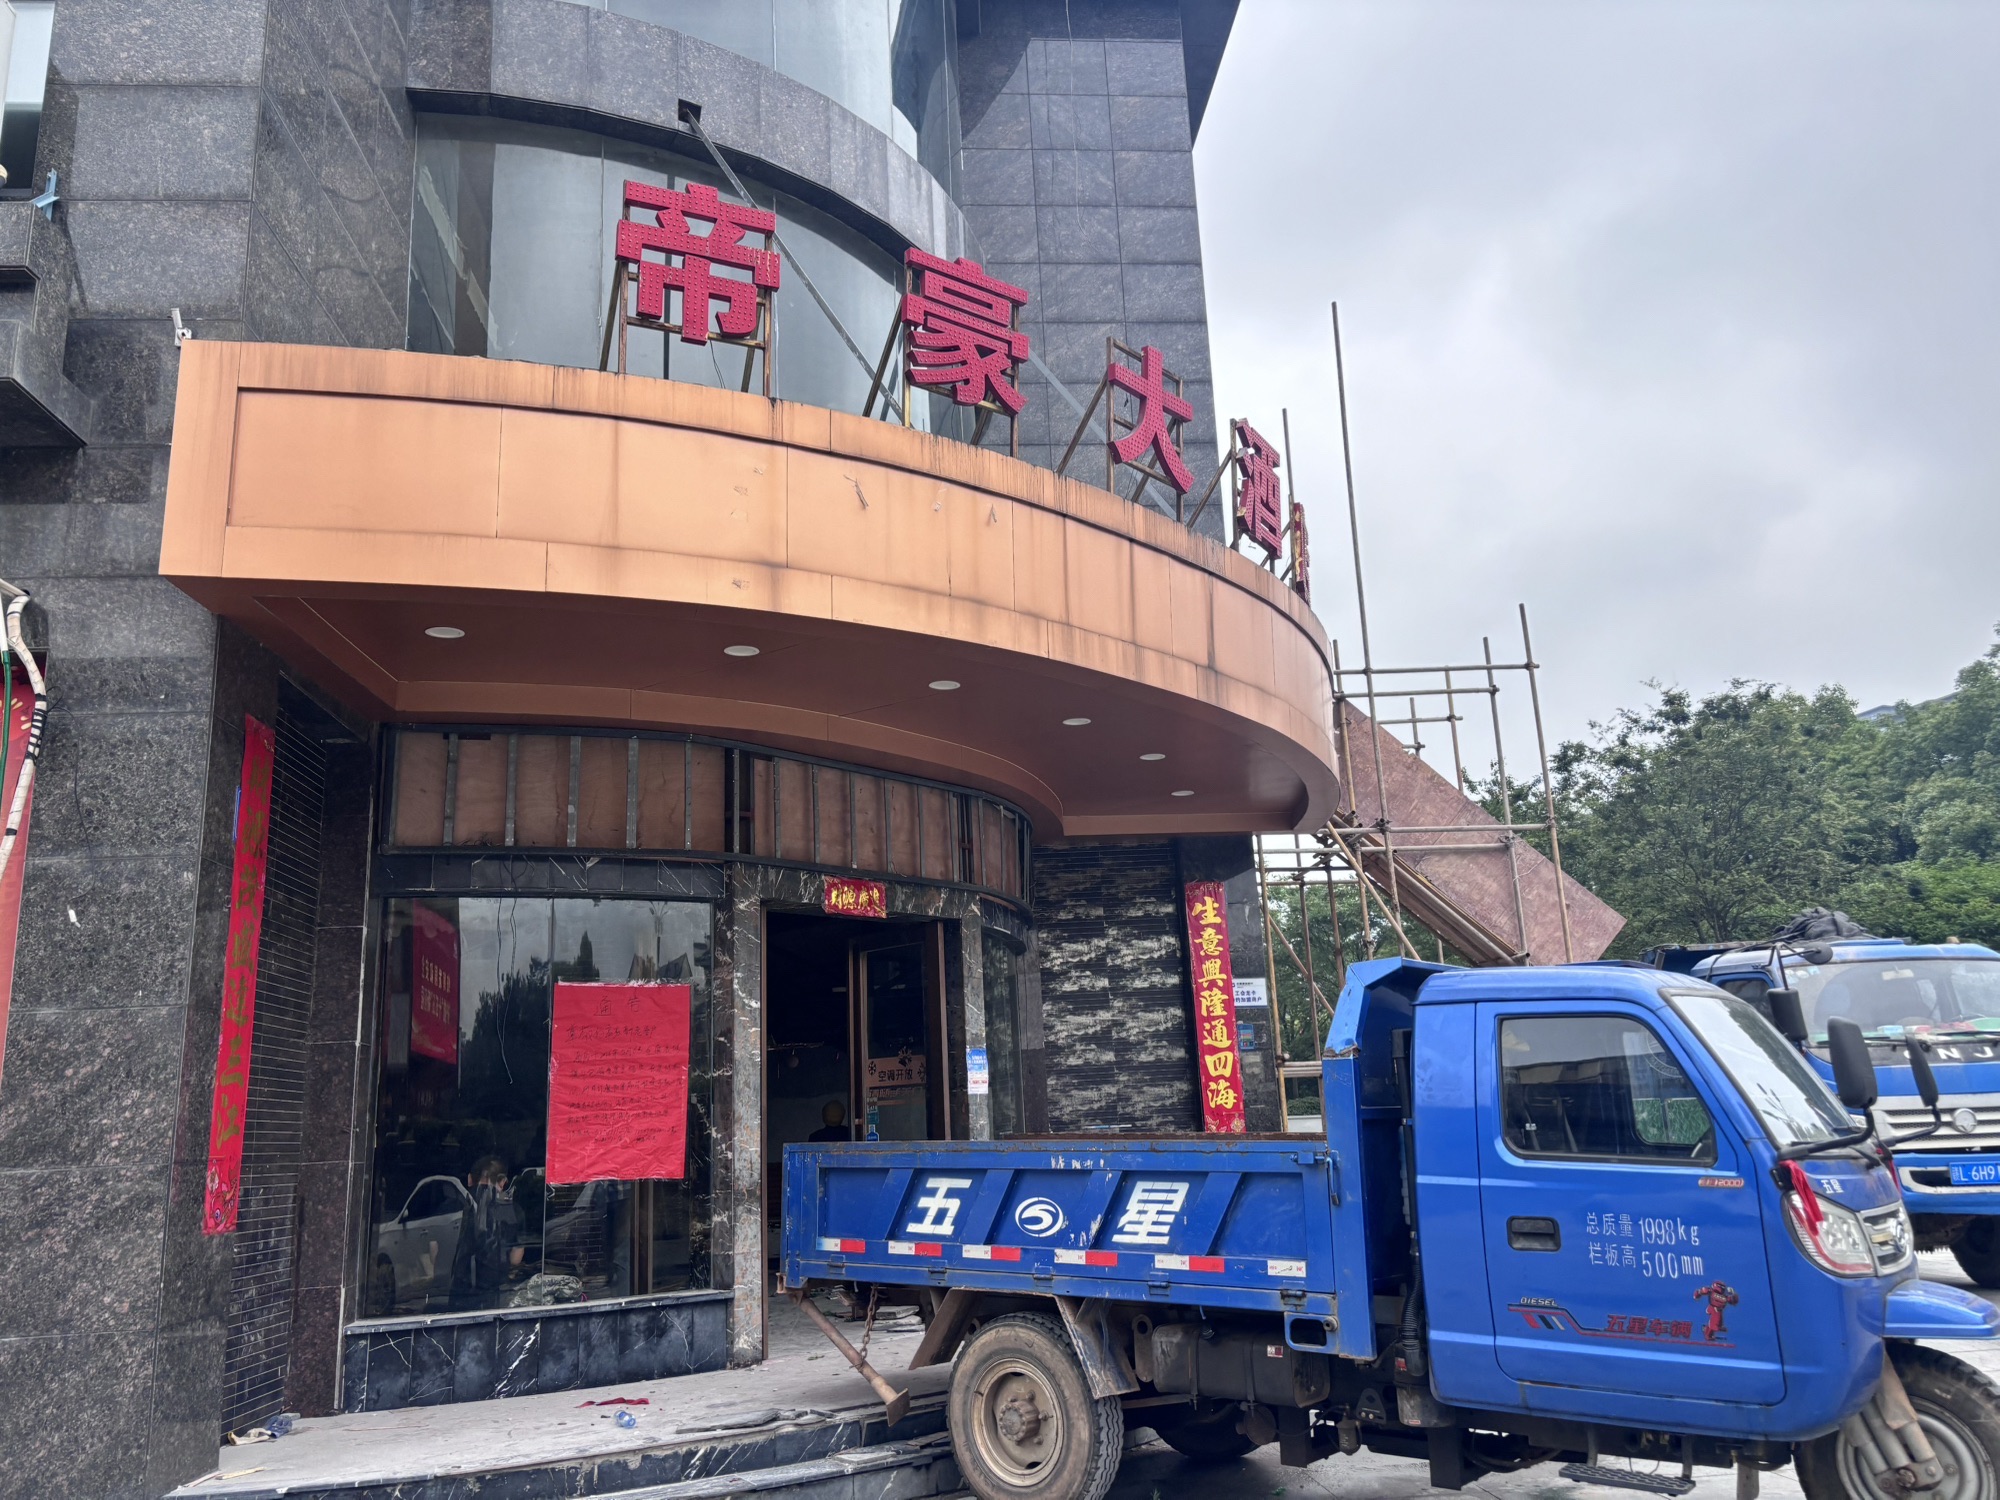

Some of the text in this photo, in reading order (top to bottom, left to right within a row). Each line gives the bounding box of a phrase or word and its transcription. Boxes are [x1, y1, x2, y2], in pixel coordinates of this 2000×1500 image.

[1191, 895, 1238, 1110] 生意興隆通四海
[1233, 996, 1262, 1004] 约加盟商户
[878, 1068, 913, 1083] 空调开放
[1821, 1179, 1844, 1194] 五星
[1586, 1211, 1634, 1238] 总质量
[1588, 1241, 1637, 1268] 栏板高
[1520, 1297, 1558, 1307] DIESEL
[1604, 1314, 1692, 1338] 五星车辆
